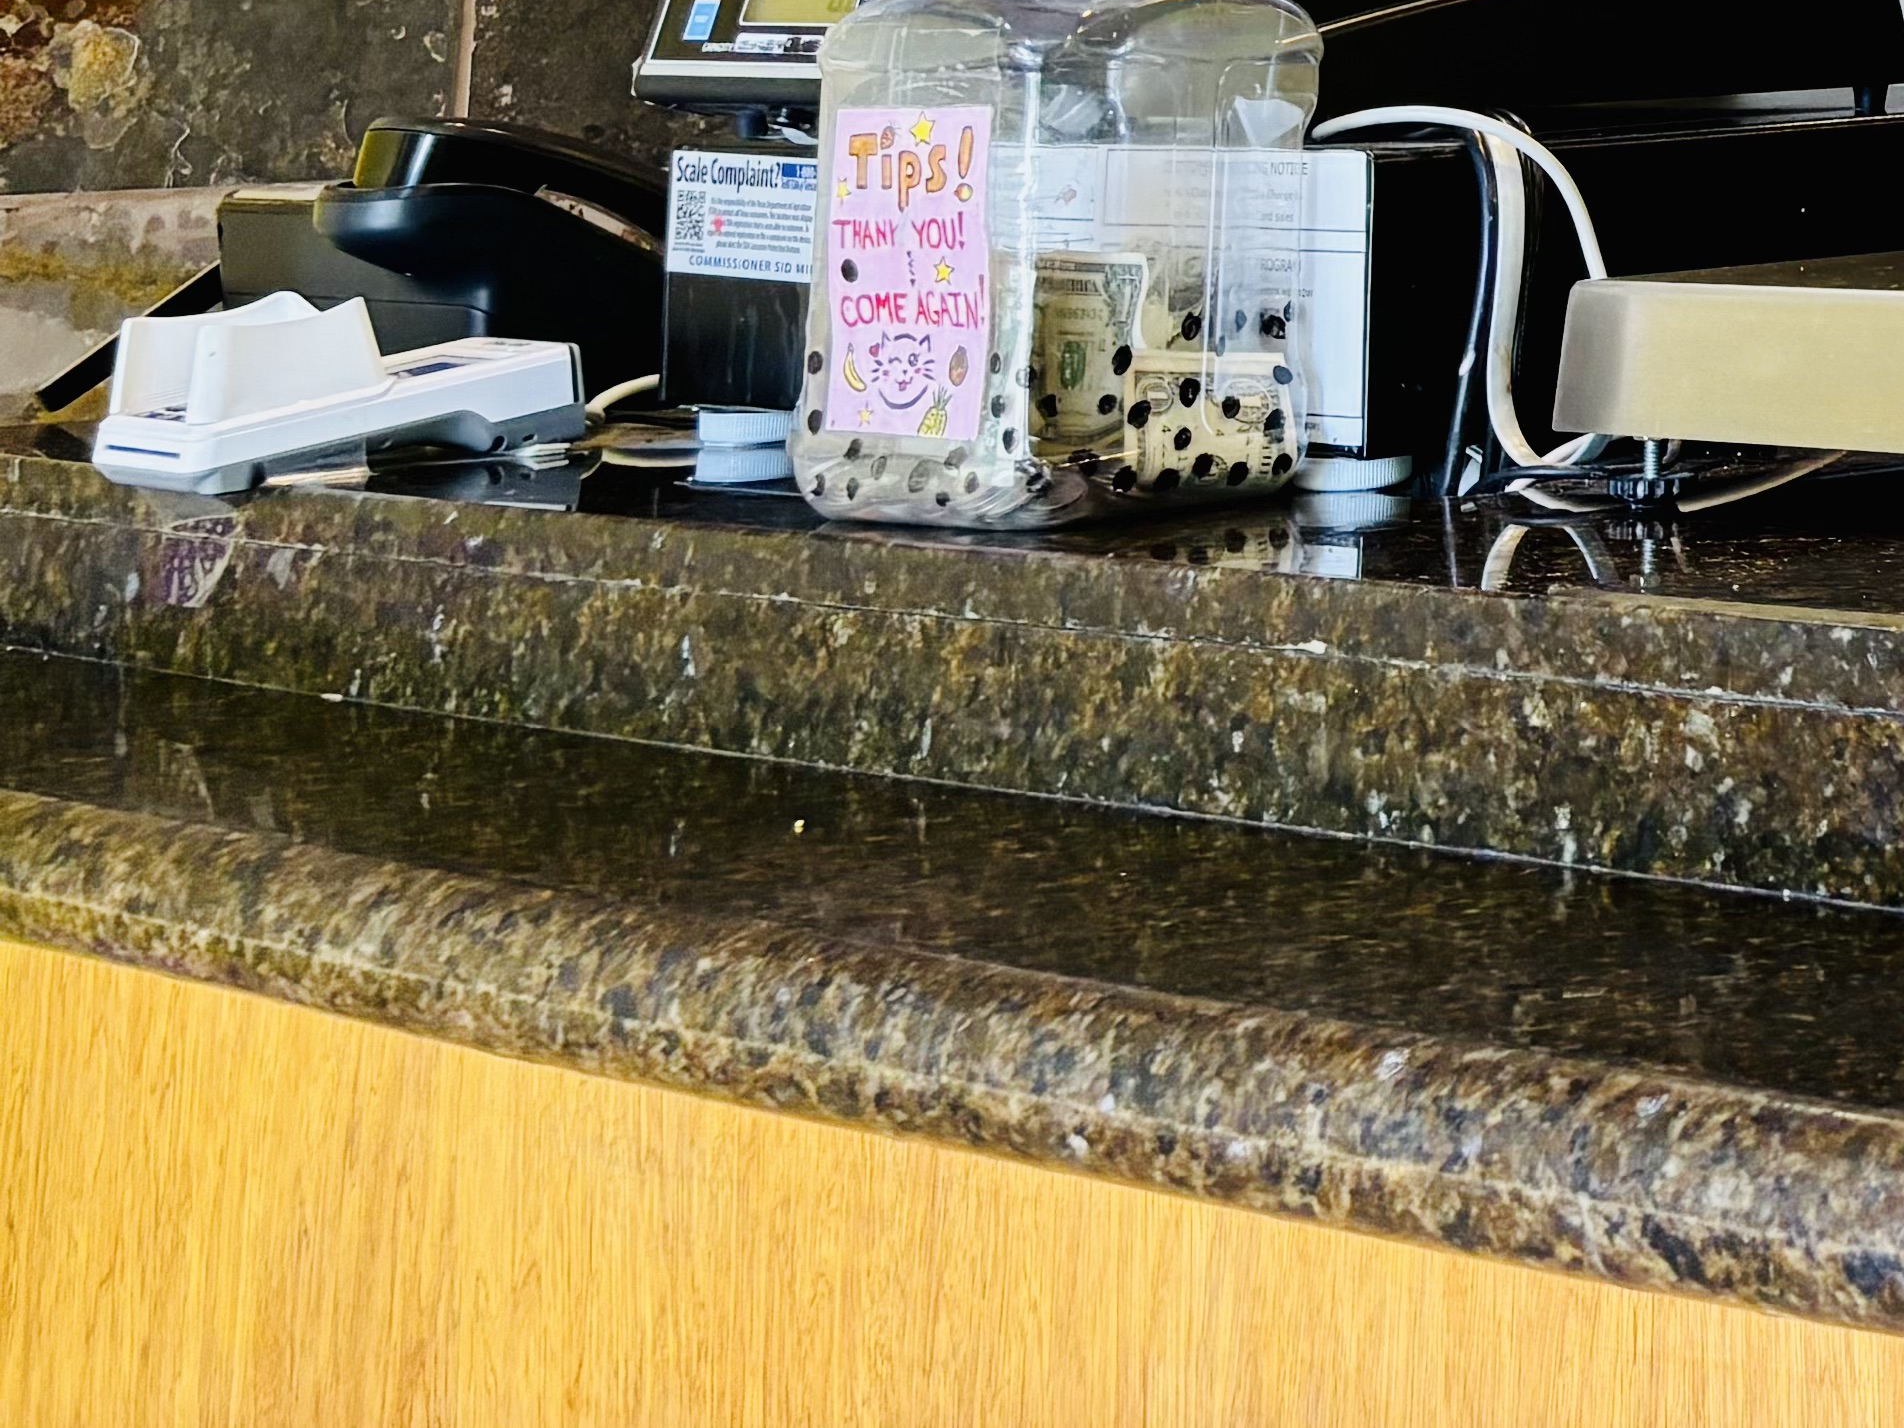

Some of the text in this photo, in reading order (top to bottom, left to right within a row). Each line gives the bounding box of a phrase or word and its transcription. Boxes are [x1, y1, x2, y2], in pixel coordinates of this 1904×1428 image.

[676, 156, 707, 184] Scale
[711, 158, 781, 193] Complaint?
[849, 120, 974, 213] Tips!
[911, 211, 965, 250] YOU!
[689, 255, 771, 272] COMMISSIONER
[775, 261, 792, 273] SID
[840, 274, 985, 329] COME AGAIN!
